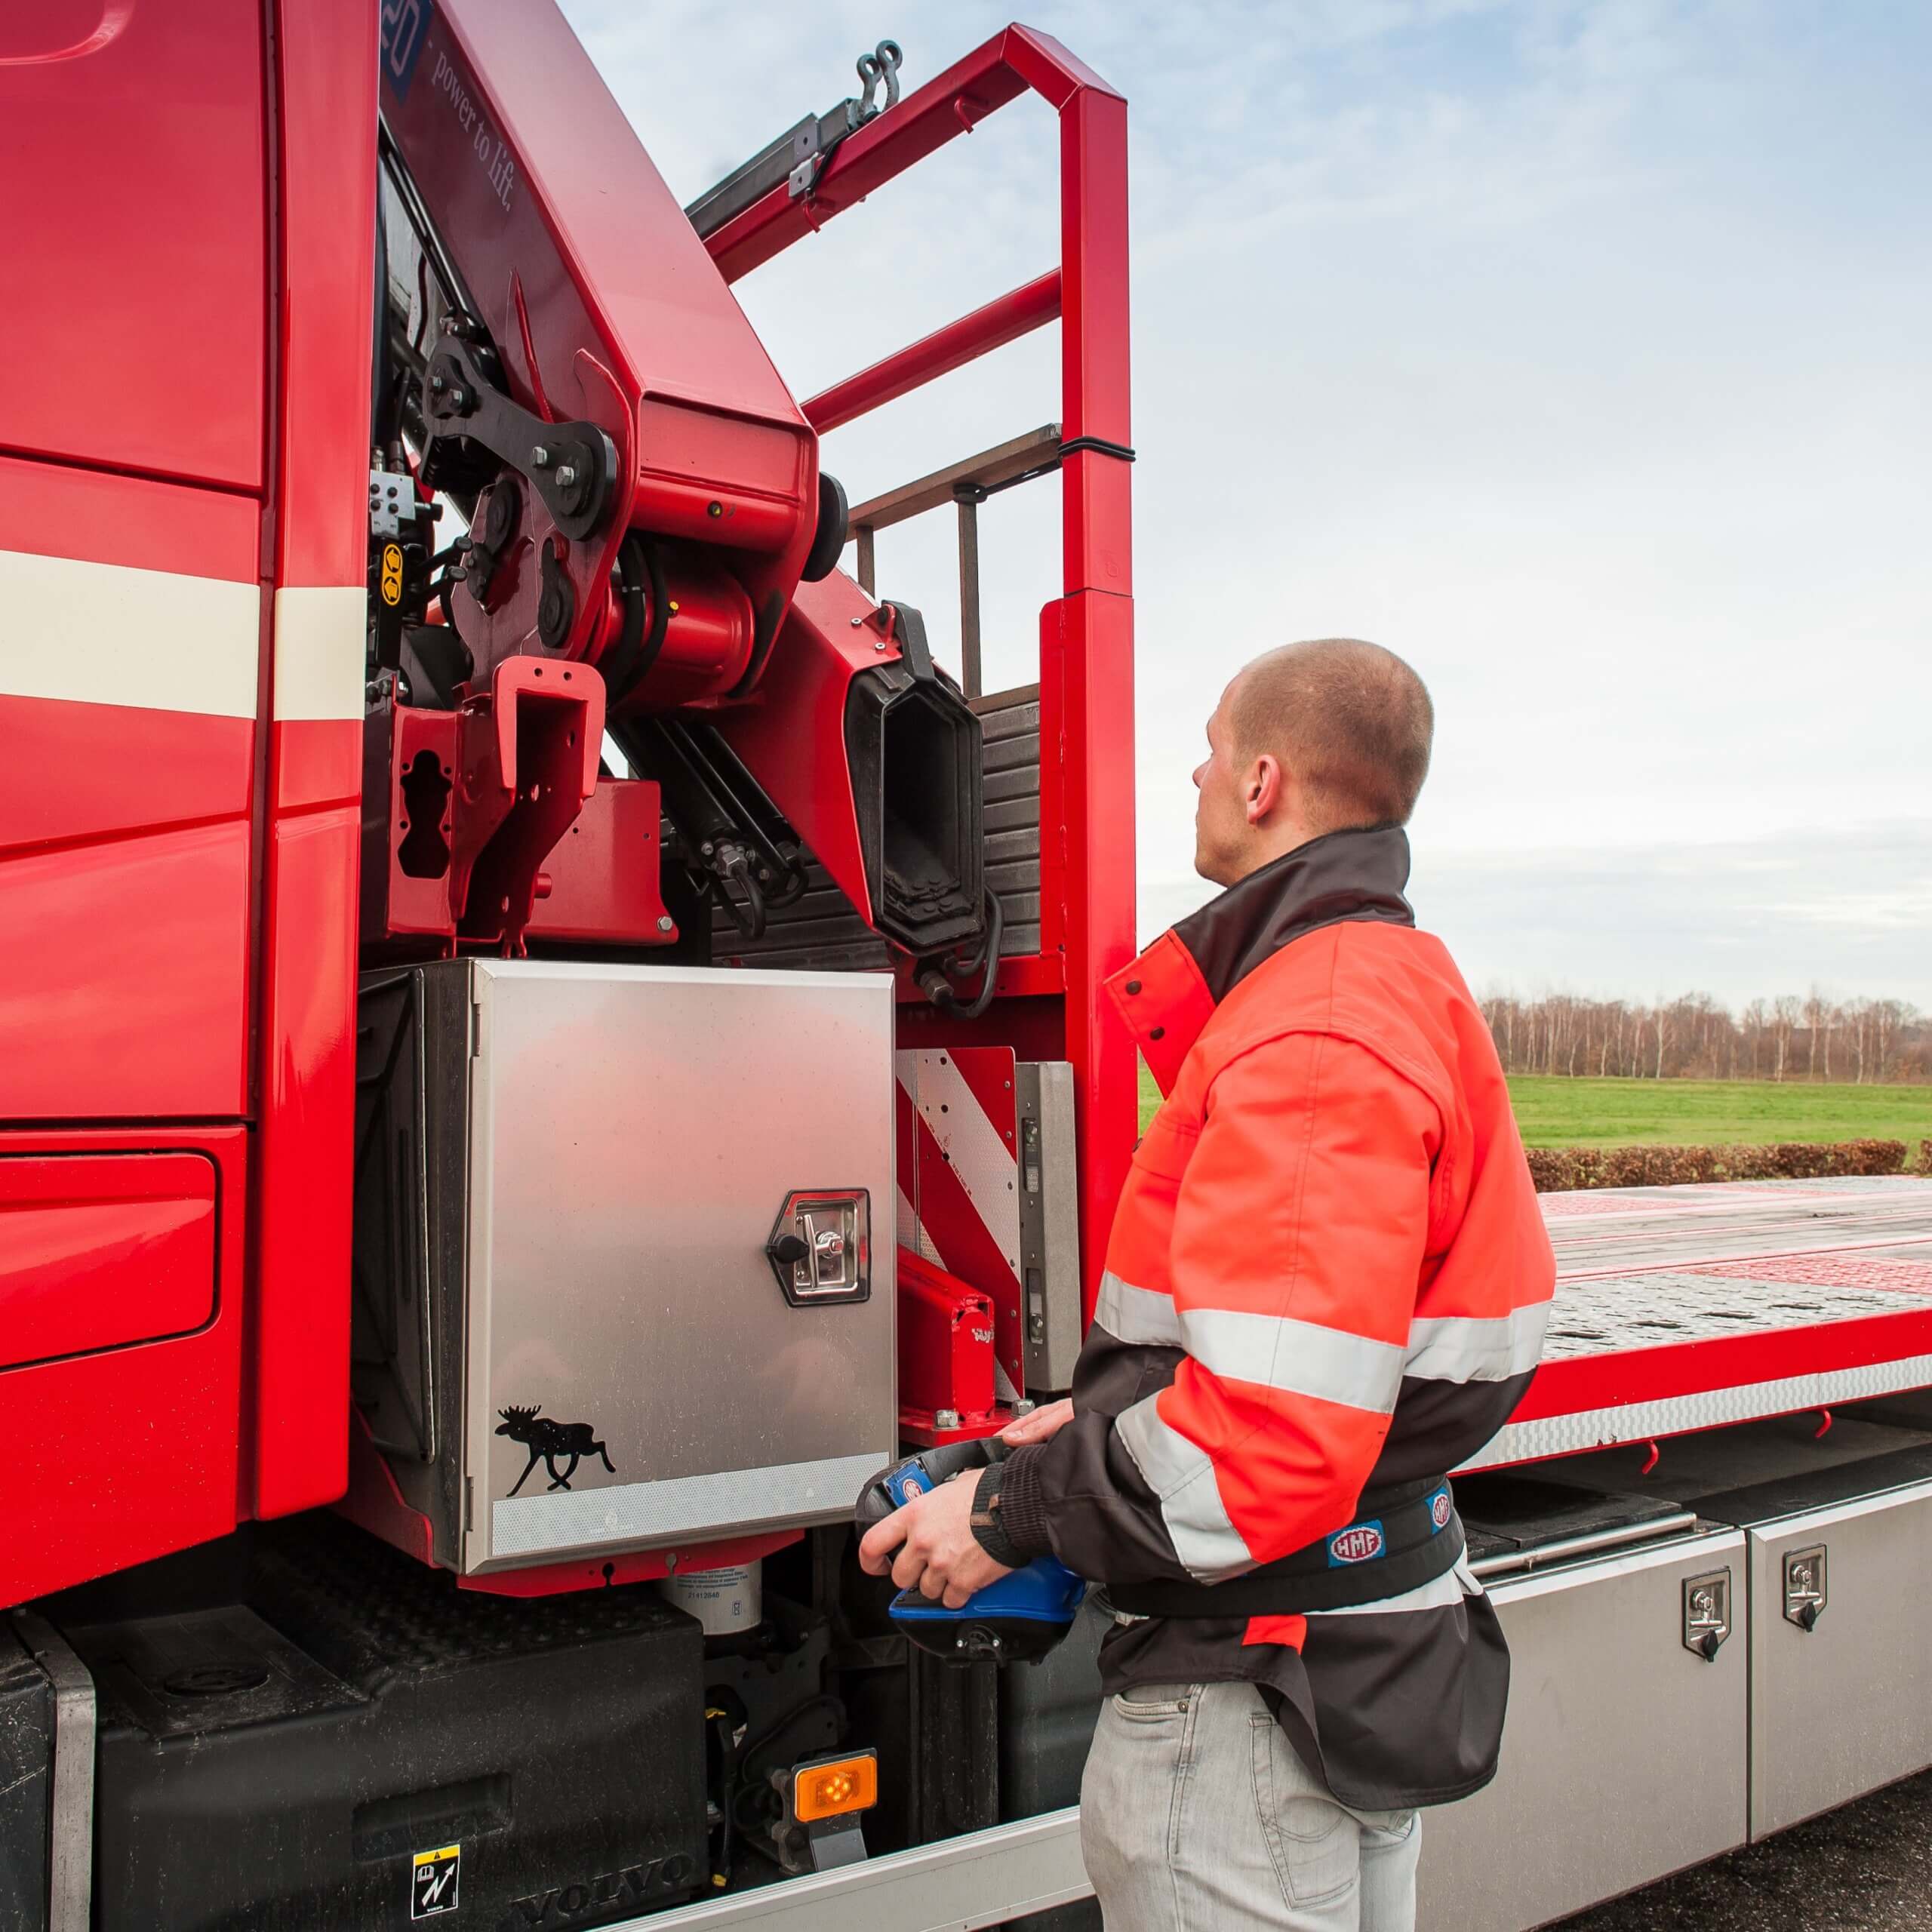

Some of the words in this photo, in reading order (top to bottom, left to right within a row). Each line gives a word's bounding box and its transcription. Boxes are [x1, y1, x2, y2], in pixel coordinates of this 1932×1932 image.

[432, 50, 476, 133] power
[473, 120, 491, 162] to
[488, 141, 515, 212] lift.
[1435, 1497, 1448, 1523] HMF
[1336, 1533, 1377, 1557] HMF
[511, 1853, 695, 1924] VOLVO
